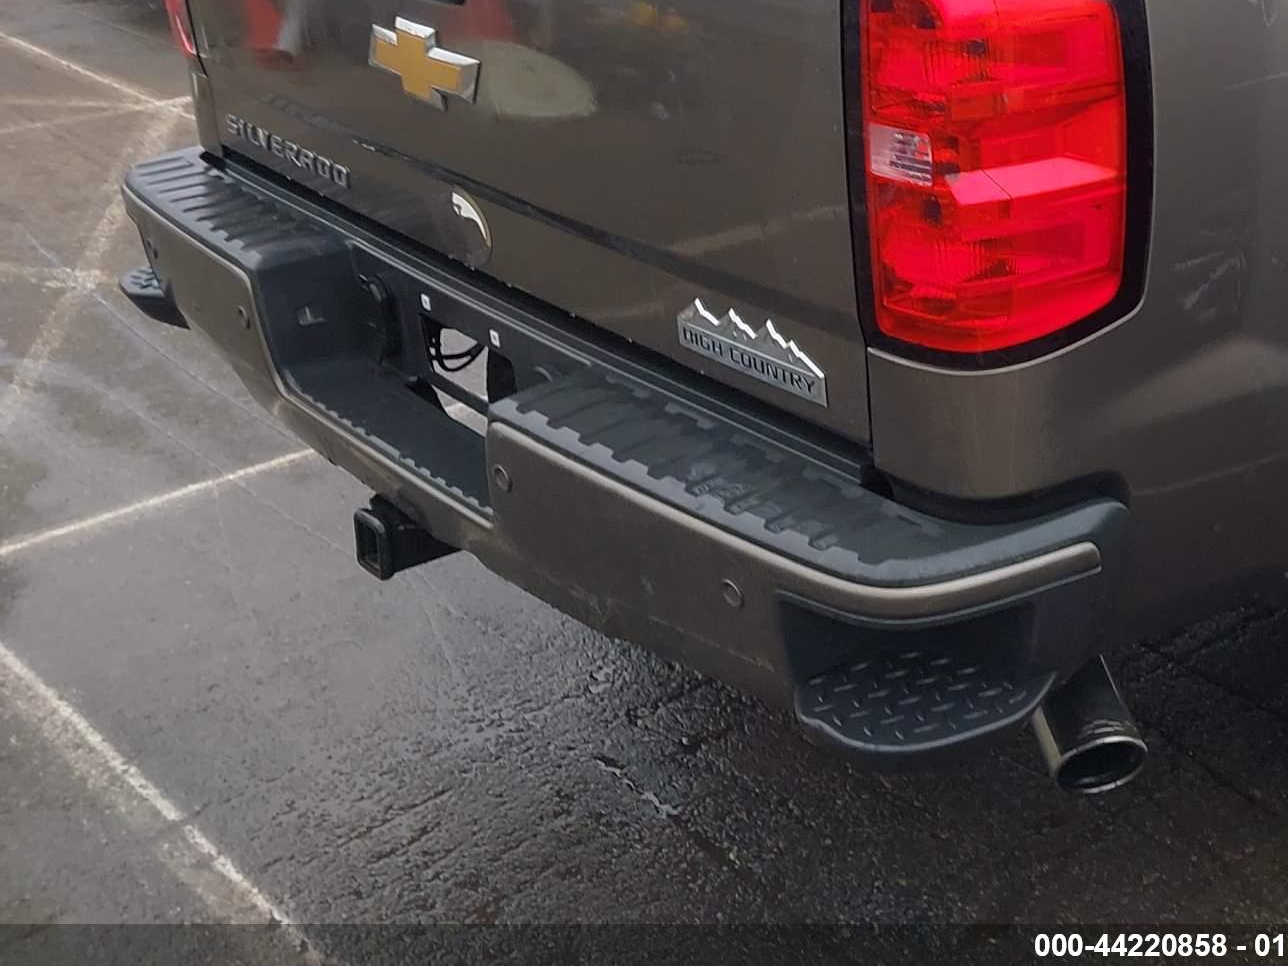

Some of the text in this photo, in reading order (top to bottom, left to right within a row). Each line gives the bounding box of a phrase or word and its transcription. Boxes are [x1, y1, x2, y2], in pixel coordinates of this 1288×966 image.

[226, 113, 351, 189] SILVERADO
[682, 327, 815, 394] HIGH COUNTRY
